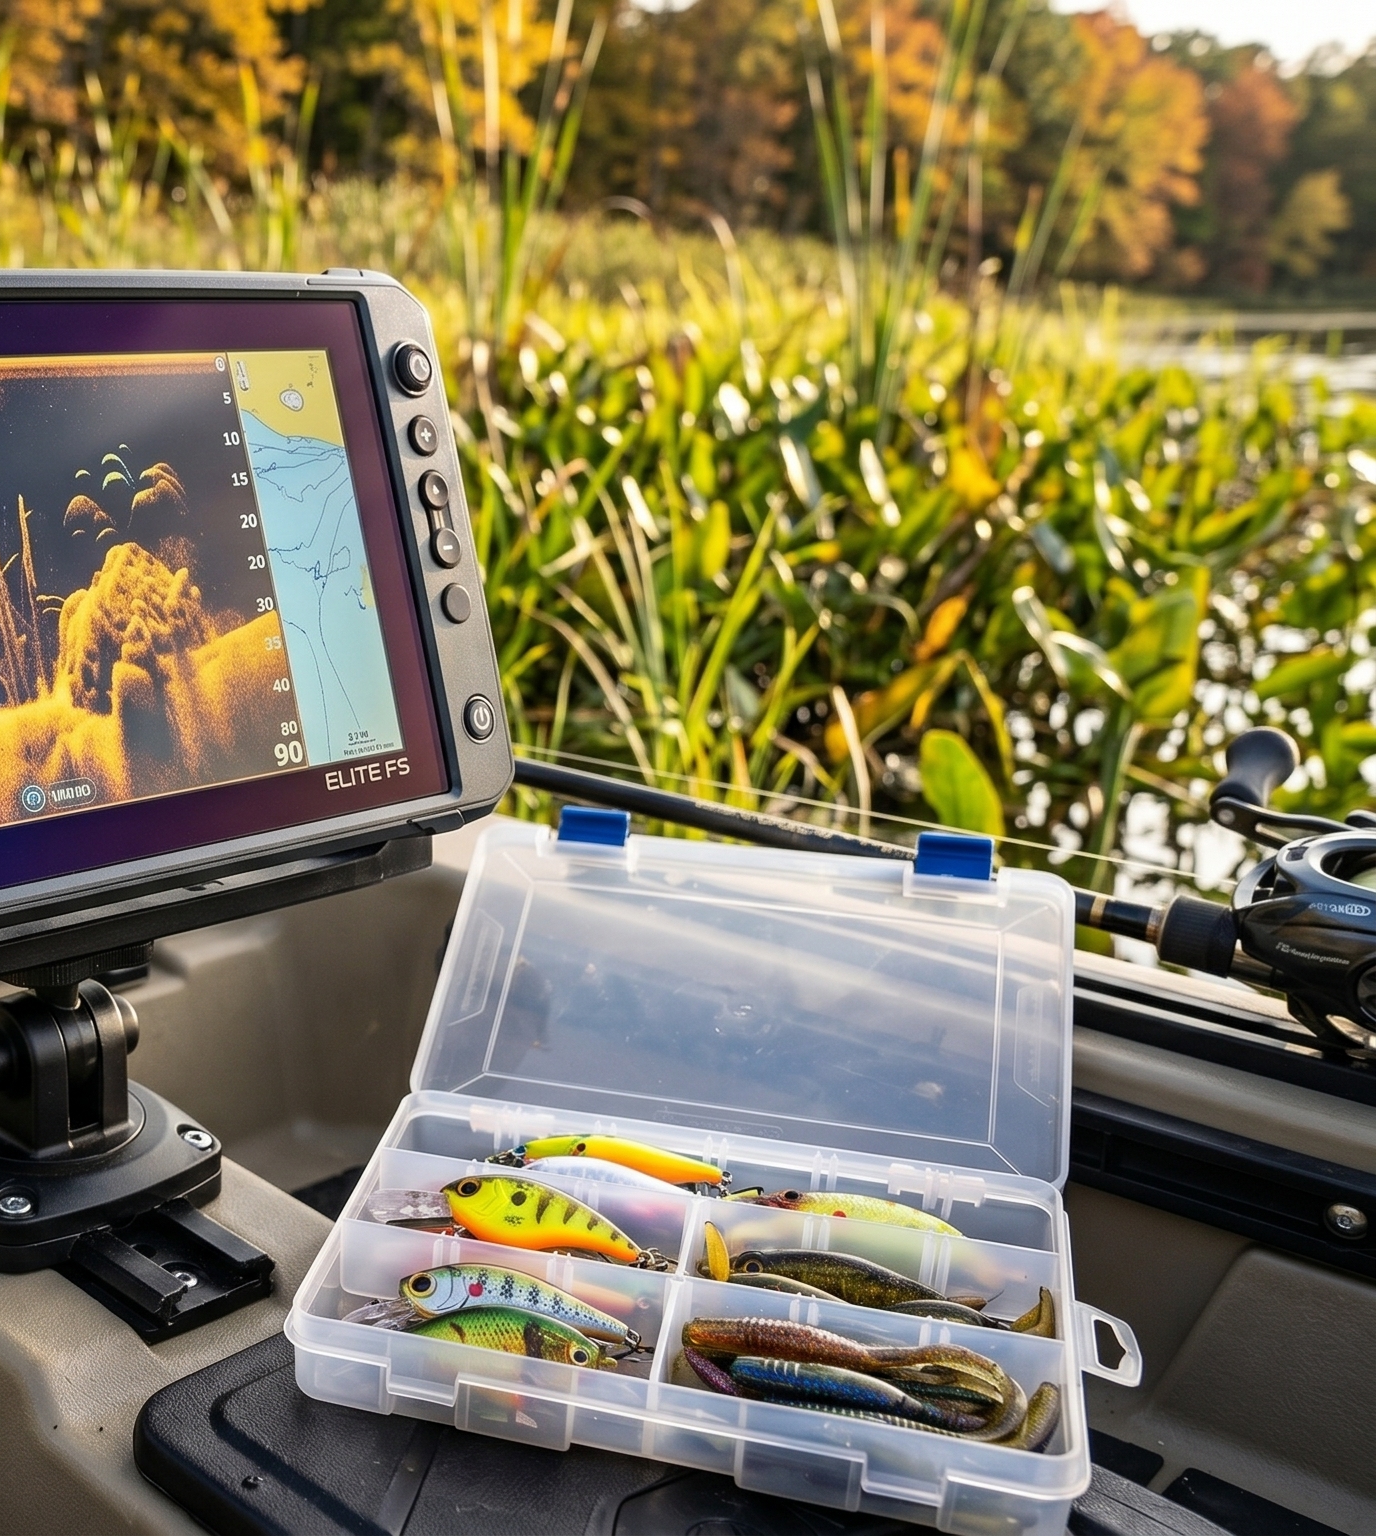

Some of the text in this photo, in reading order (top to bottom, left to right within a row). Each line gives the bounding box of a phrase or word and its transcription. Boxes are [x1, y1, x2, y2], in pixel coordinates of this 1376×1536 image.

[223, 392, 232, 404] 5
[223, 431, 240, 446] 10
[231, 472, 249, 486] 15
[240, 513, 258, 529] 20
[247, 554, 266, 570] 20
[256, 597, 274, 612] 30
[264, 636, 282, 650] 35
[273, 677, 290, 692] 40
[274, 740, 303, 766] 90
[325, 757, 411, 791] ELITE FS
